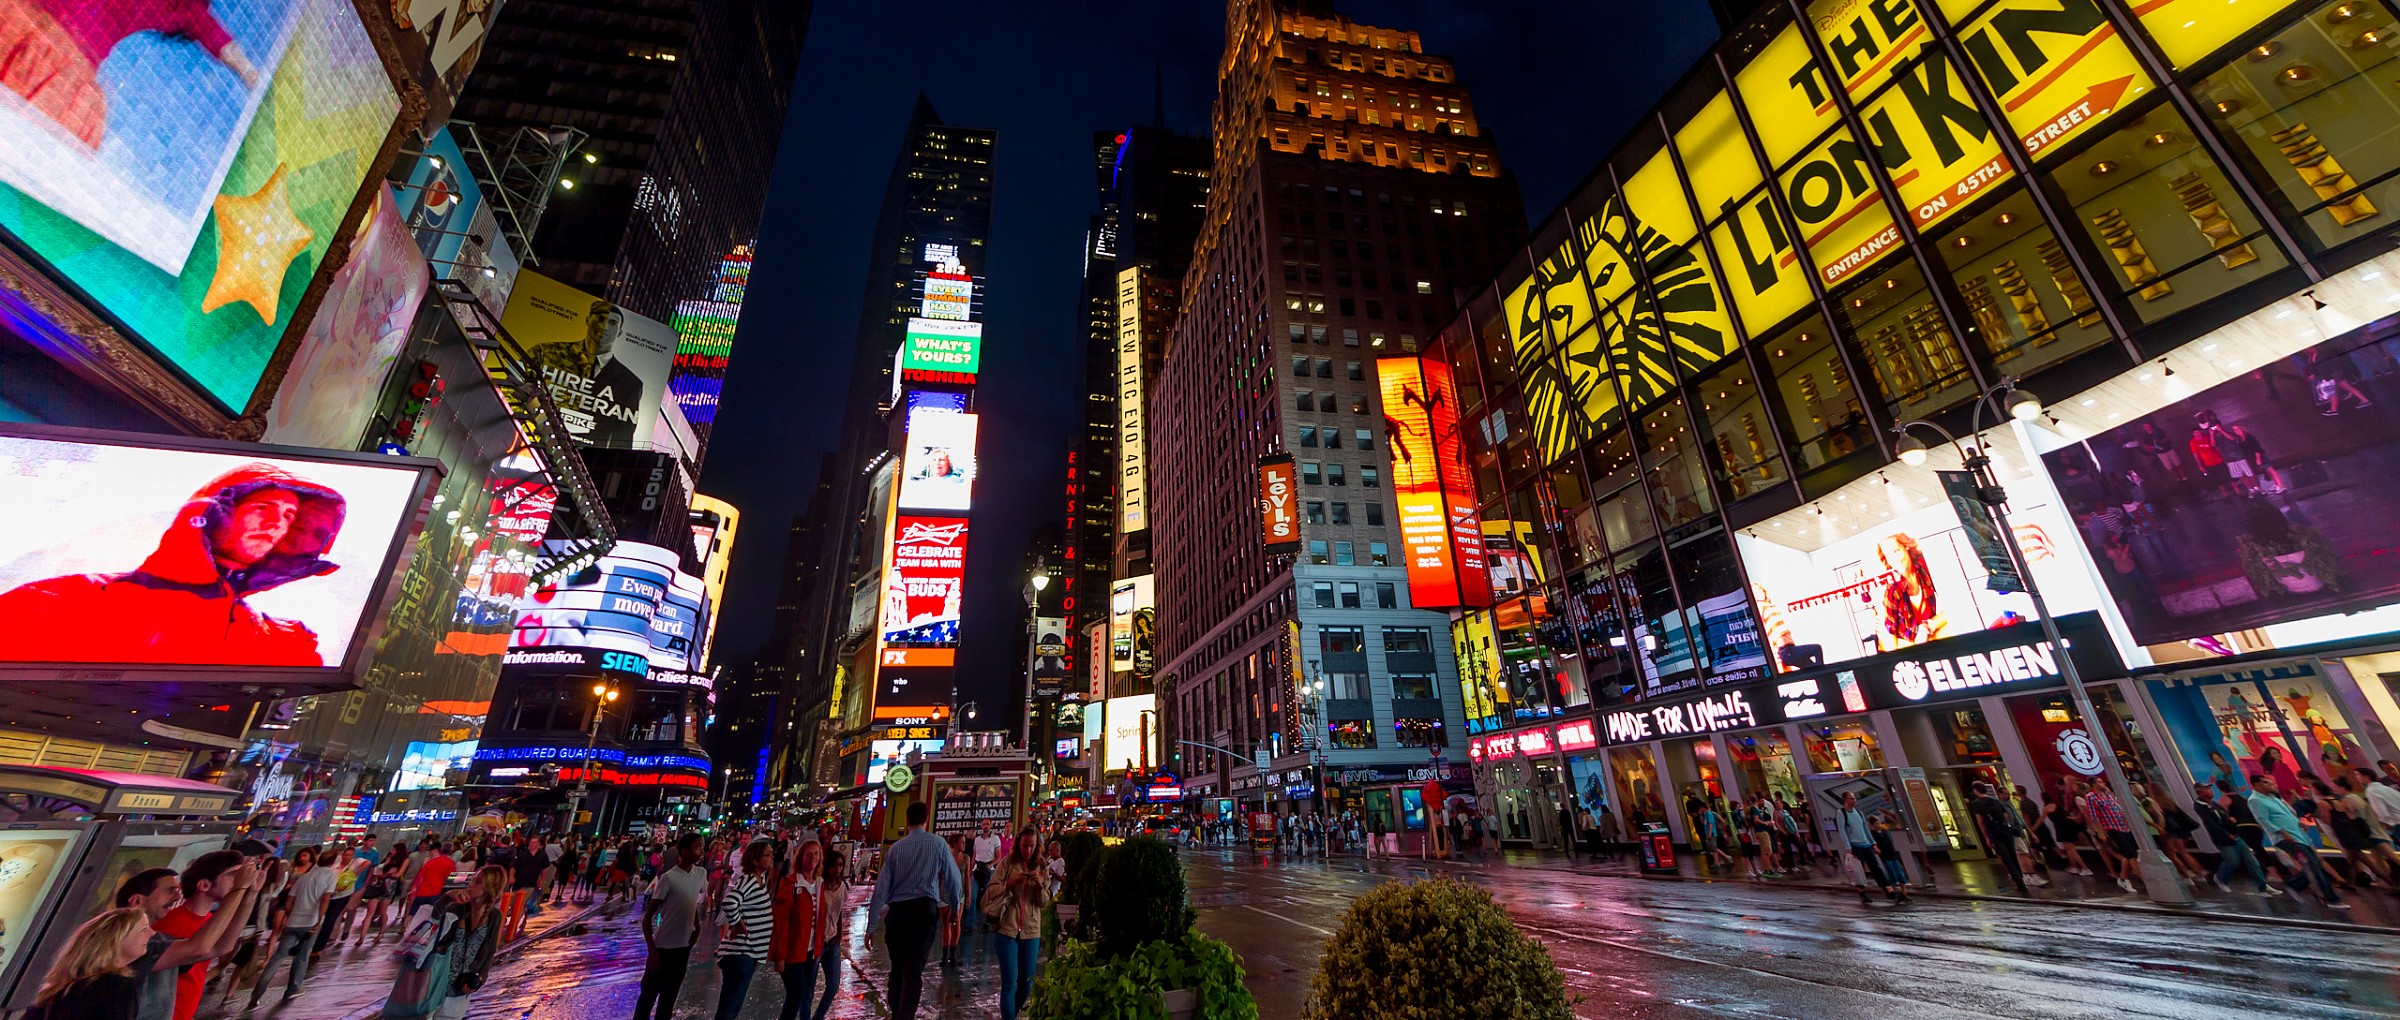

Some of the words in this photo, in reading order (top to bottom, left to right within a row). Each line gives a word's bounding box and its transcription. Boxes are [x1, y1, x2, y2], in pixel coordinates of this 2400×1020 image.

[1789, 0, 1919, 109] THE
[1826, 227, 1898, 280] ENTRANCE
[1919, 196, 1948, 220] ON
[1956, 161, 2002, 197] 45TH
[2025, 102, 2092, 152] STREET
[1720, 106, 1912, 296] LION
[936, 263, 966, 275] 2012
[932, 285, 964, 293] EVERY
[1122, 276, 1135, 308] THE
[530, 296, 565, 313] QUALIFIED
[565, 308, 578, 317] FOR
[925, 294, 969, 304] SUMMER
[930, 302, 951, 310] HAS
[953, 304, 962, 312] A
[530, 302, 575, 321] DEPLOYMENT.
[928, 312, 962, 320] STORY
[625, 332, 656, 347] QUALIFIED
[656, 343, 668, 351] FOR
[1122, 316, 1136, 354] NEW
[625, 337, 665, 355] EMPLOYMENT.
[914, 338, 971, 351] WHAT'S
[911, 351, 972, 364] YOURS?
[542, 364, 596, 394] HIRE
[597, 385, 614, 401] A
[903, 370, 976, 384] TOSHIBA
[1123, 365, 1137, 400] HTC
[561, 412, 597, 430] PIKE
[1126, 454, 1140, 476] 4G
[641, 454, 665, 511] 1500
[1066, 452, 1077, 529] ERNST
[1126, 489, 1141, 523] LTE
[897, 545, 963, 558] CELEBRATE
[1064, 547, 1075, 559] &
[896, 558, 920, 567] TEAM
[921, 559, 939, 568] USA
[940, 559, 962, 568] WITH
[620, 578, 654, 595] Even
[663, 605, 677, 618] can
[908, 584, 946, 597] BUDS
[1063, 577, 1075, 671] YOUNG
[884, 651, 907, 664] FX
[502, 651, 585, 665] information.
[646, 668, 655, 680] In
[656, 671, 688, 684] cities
[1608, 711, 1652, 742] MADE
[1652, 705, 1689, 735] FOR
[2215, 708, 2291, 726] RUWAY
[887, 728, 907, 738] AYED
[909, 728, 931, 738] SINCE
[1117, 727, 1140, 740] Sprin
[507, 748, 557, 760] INJURED
[626, 755, 660, 767] FAMILY
[132, 795, 160, 807] Phone
[938, 801, 971, 809] FRESH
[980, 800, 1012, 808] BAKED
[937, 808, 1011, 820] EMPANADAS
